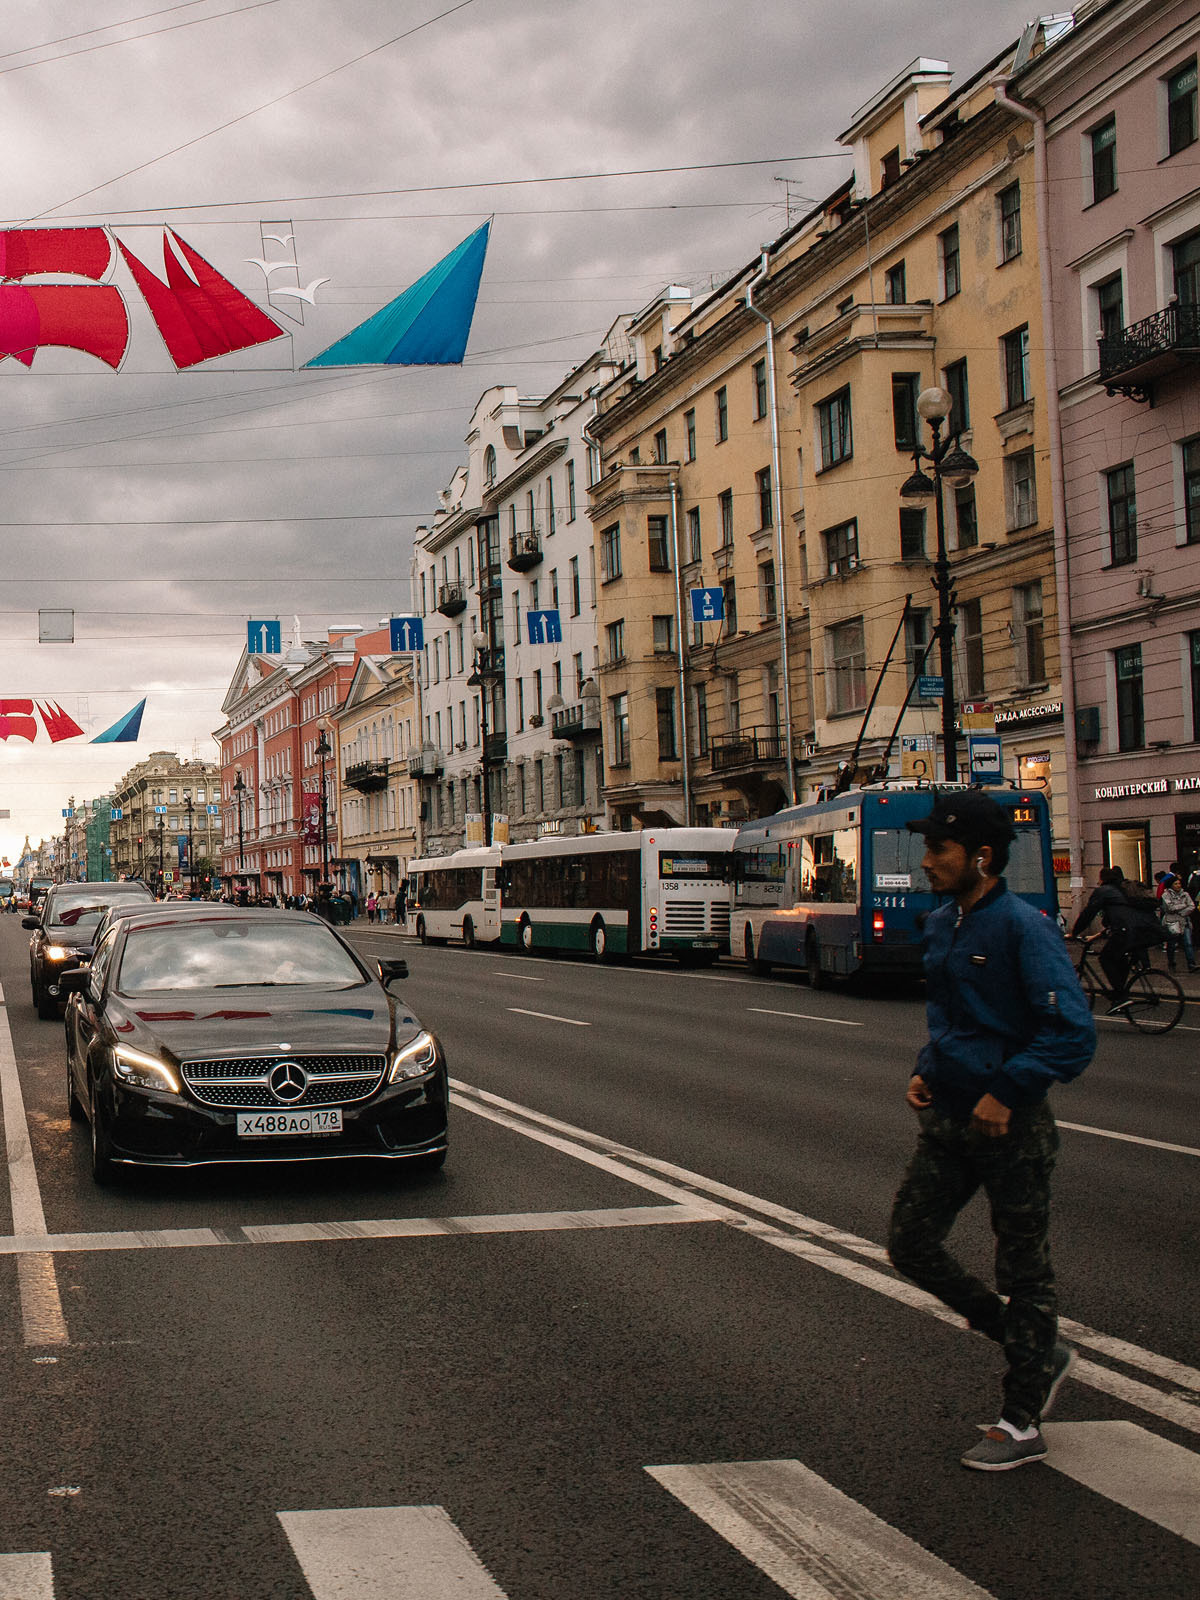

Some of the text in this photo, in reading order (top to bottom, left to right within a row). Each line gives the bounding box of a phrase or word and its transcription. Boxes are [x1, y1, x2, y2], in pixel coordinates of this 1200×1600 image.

[994, 702, 1061, 724] ДЕЖДА, АКСЕССУАРЫ
[1095, 779, 1168, 799] КОНДИТЕРСКИЙ
[1014, 808, 1032, 822] 11
[662, 882, 679, 890] 1358
[873, 896, 905, 908] 2414
[243, 1112, 338, 1133] Х488АО 178
